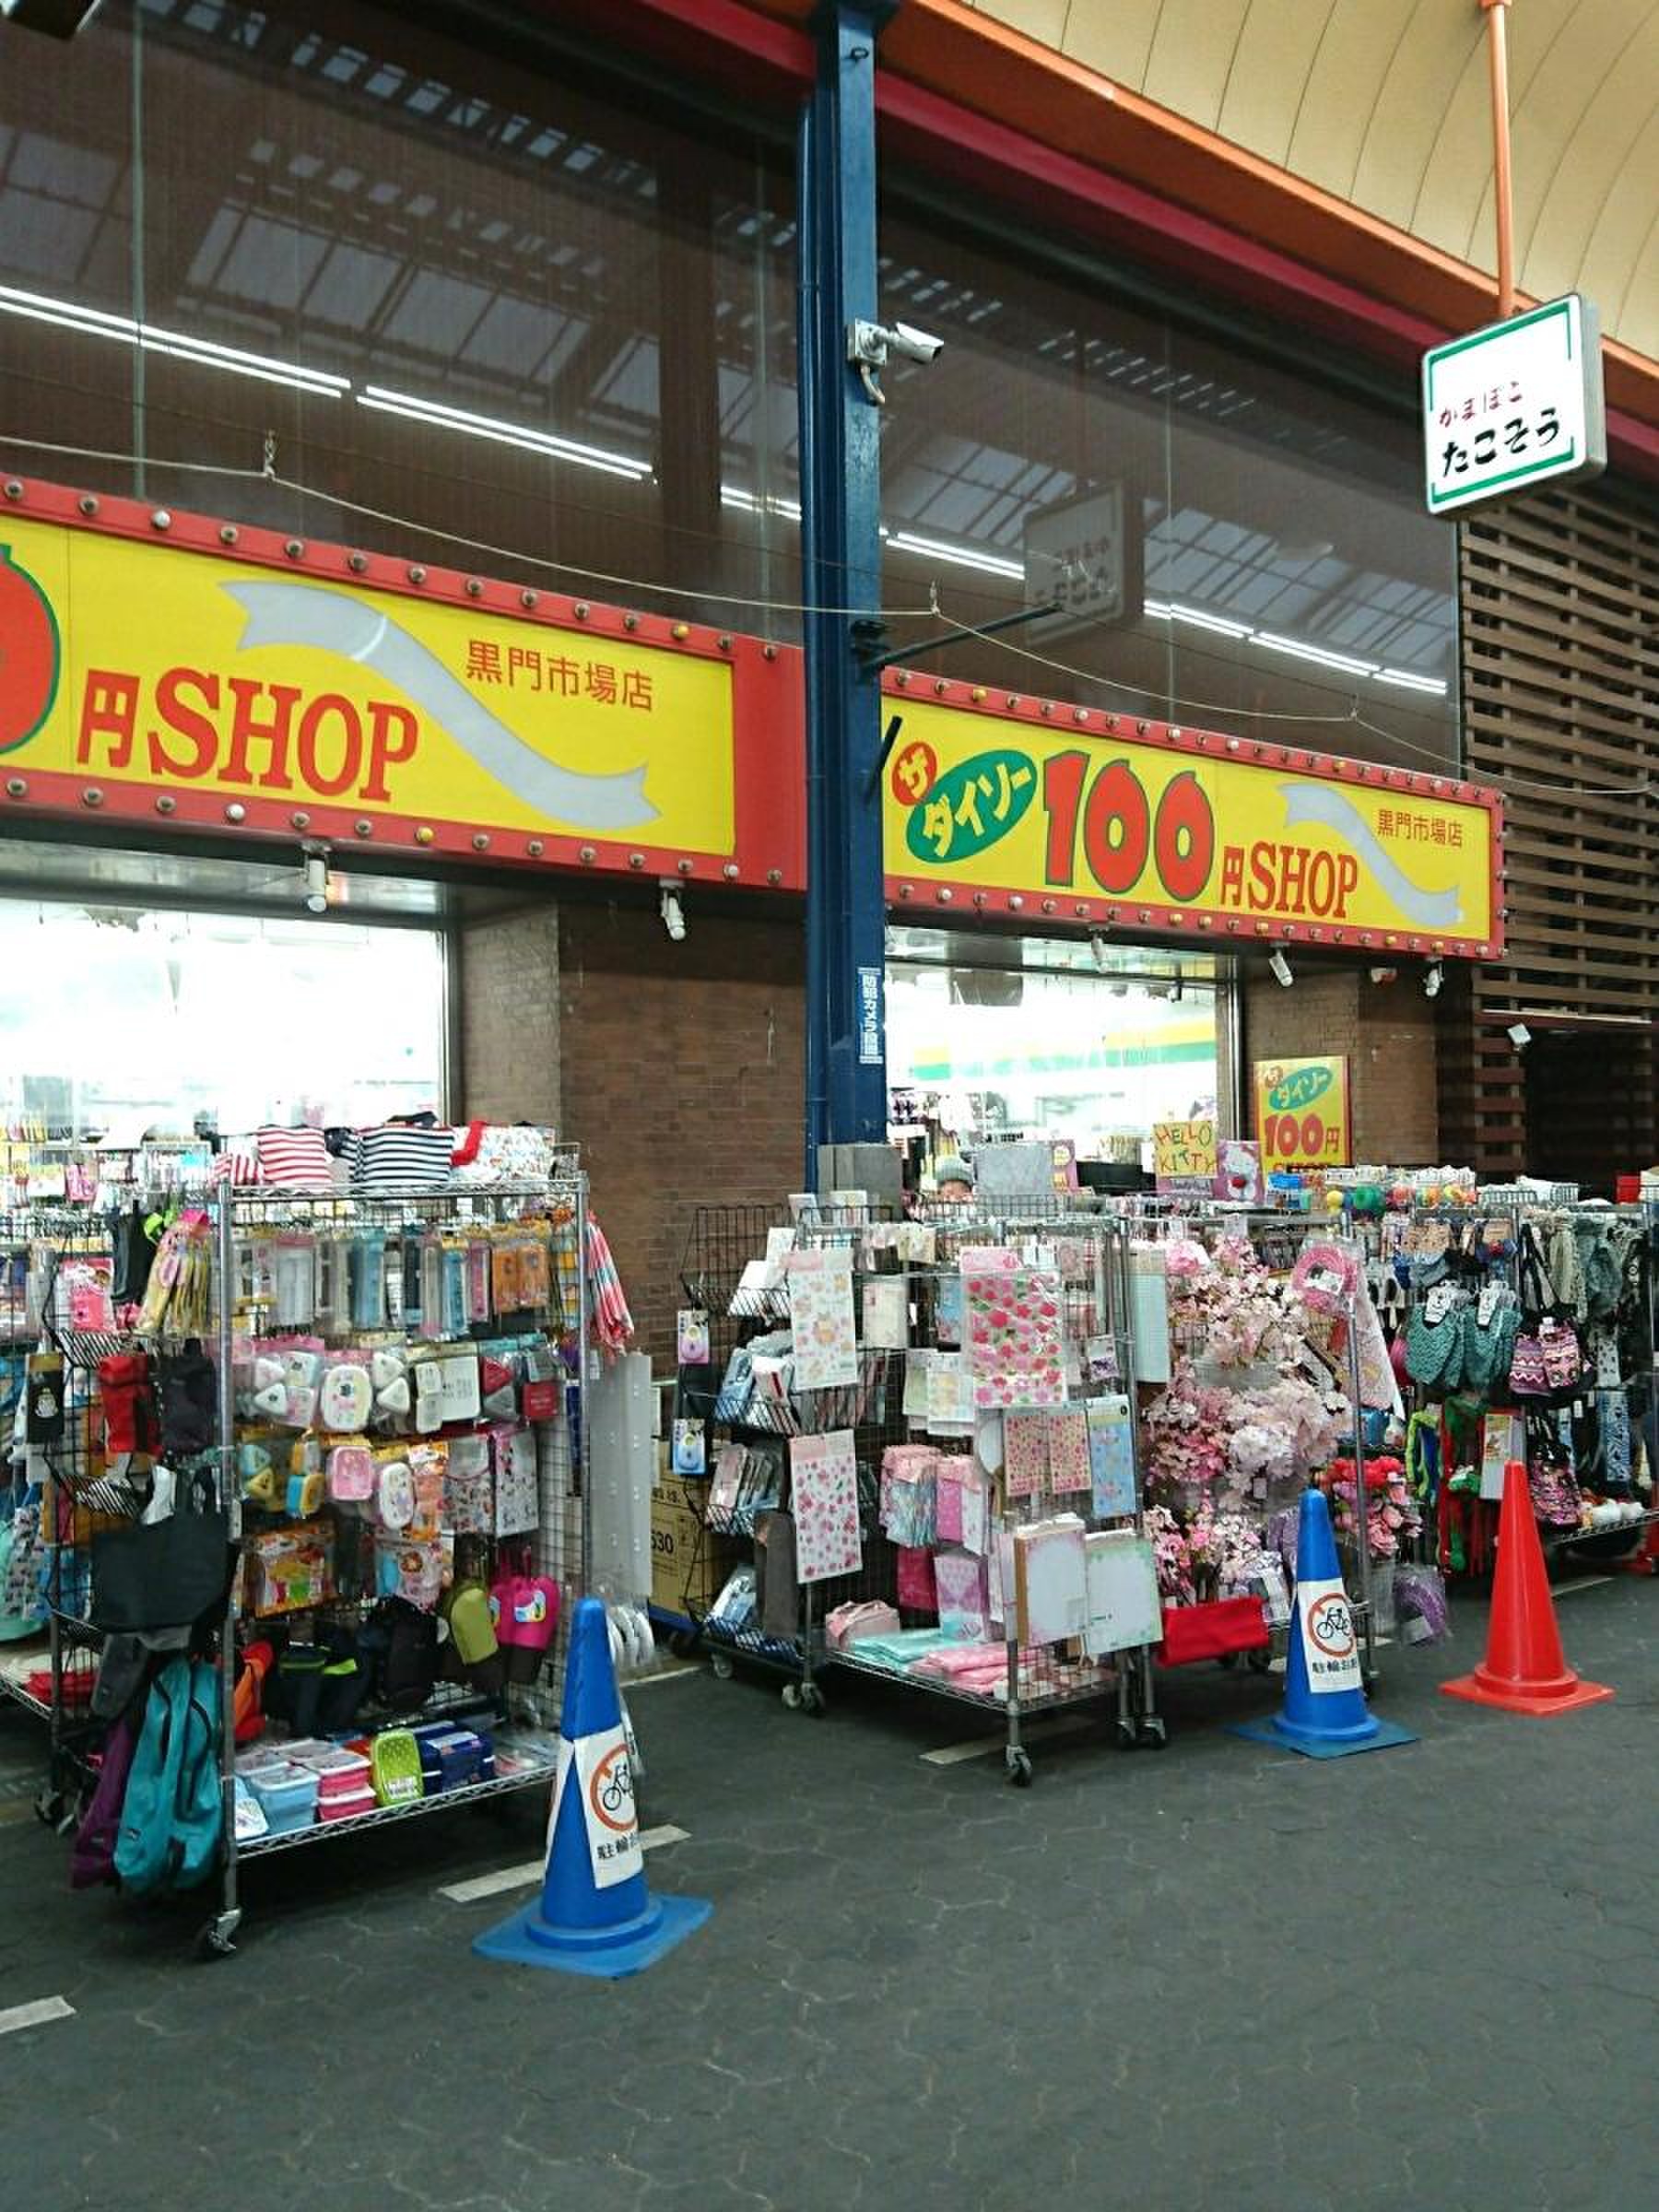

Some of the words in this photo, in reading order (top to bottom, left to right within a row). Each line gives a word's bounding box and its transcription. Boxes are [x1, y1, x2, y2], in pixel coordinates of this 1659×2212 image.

[1442, 407, 1559, 477] たこそう
[466, 640, 653, 712] 黒門市場店
[923, 763, 1032, 857] ダイソー
[1378, 808, 1463, 848] 黒門市場店
[1156, 1124, 1212, 1148] HELLO
[1159, 1149, 1216, 1173] KITTY
